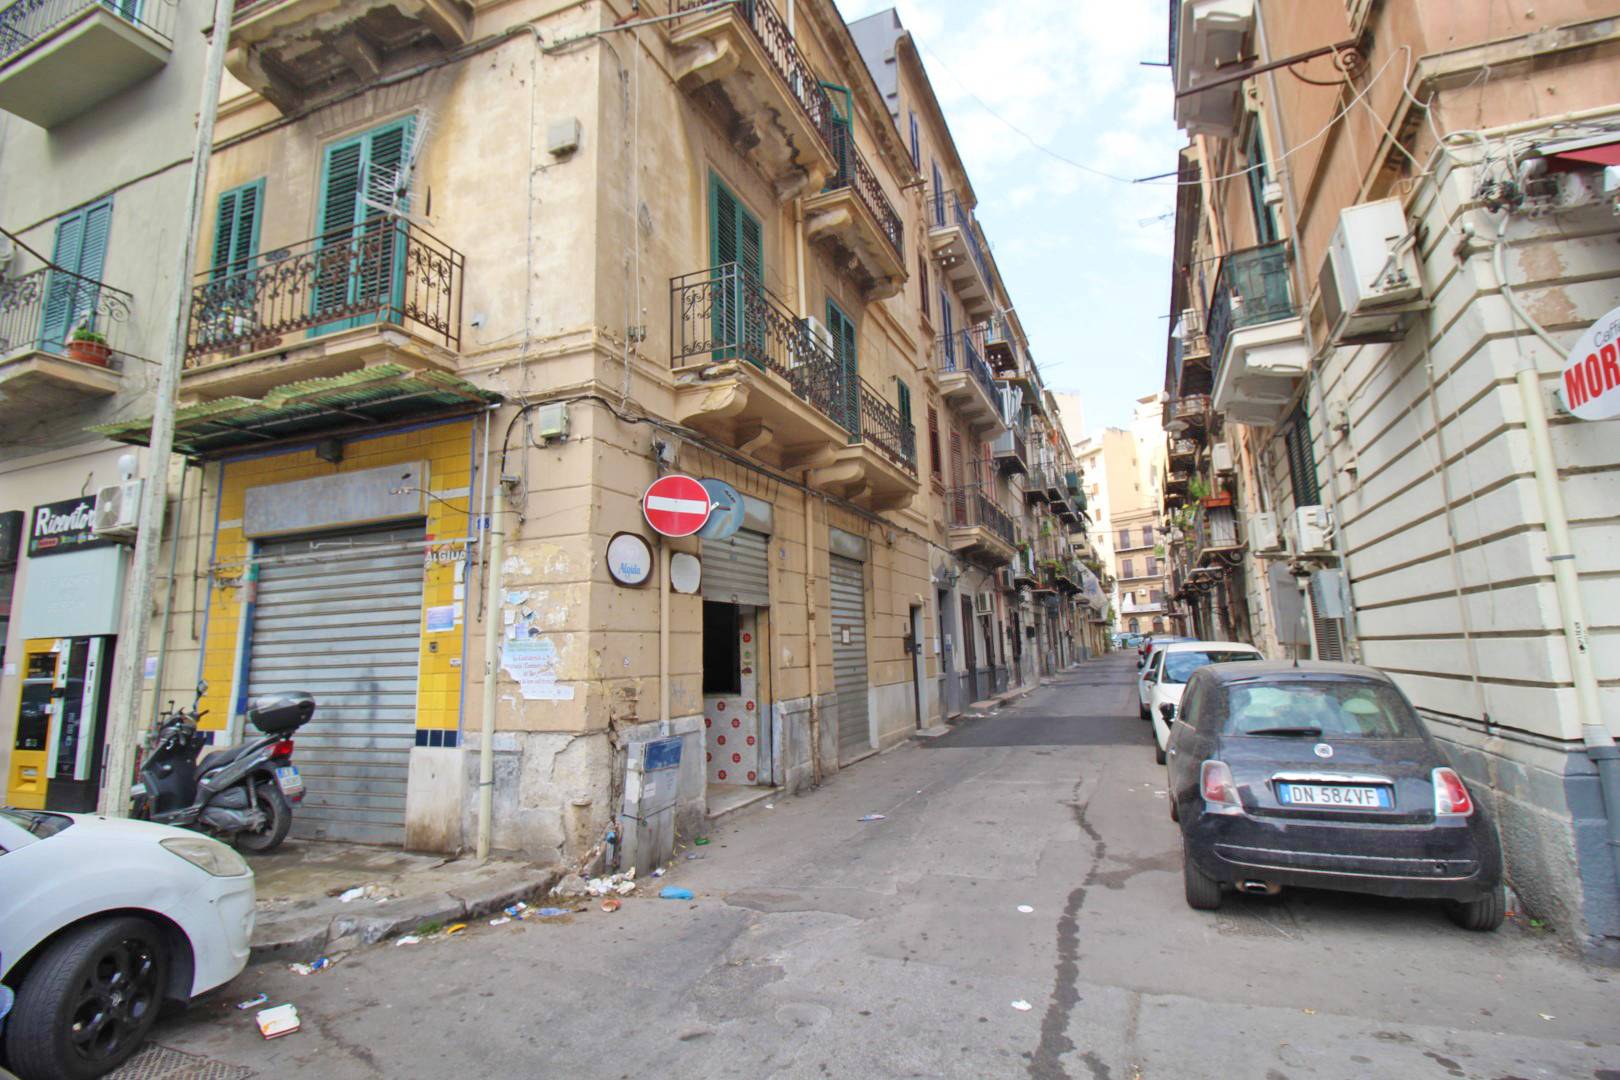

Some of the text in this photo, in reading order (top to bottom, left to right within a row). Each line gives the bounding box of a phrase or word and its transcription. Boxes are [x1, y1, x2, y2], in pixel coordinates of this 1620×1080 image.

[1564, 336, 1620, 410] MOR
[620, 561, 641, 577] Algida
[1292, 786, 1374, 805] DN 584VF
